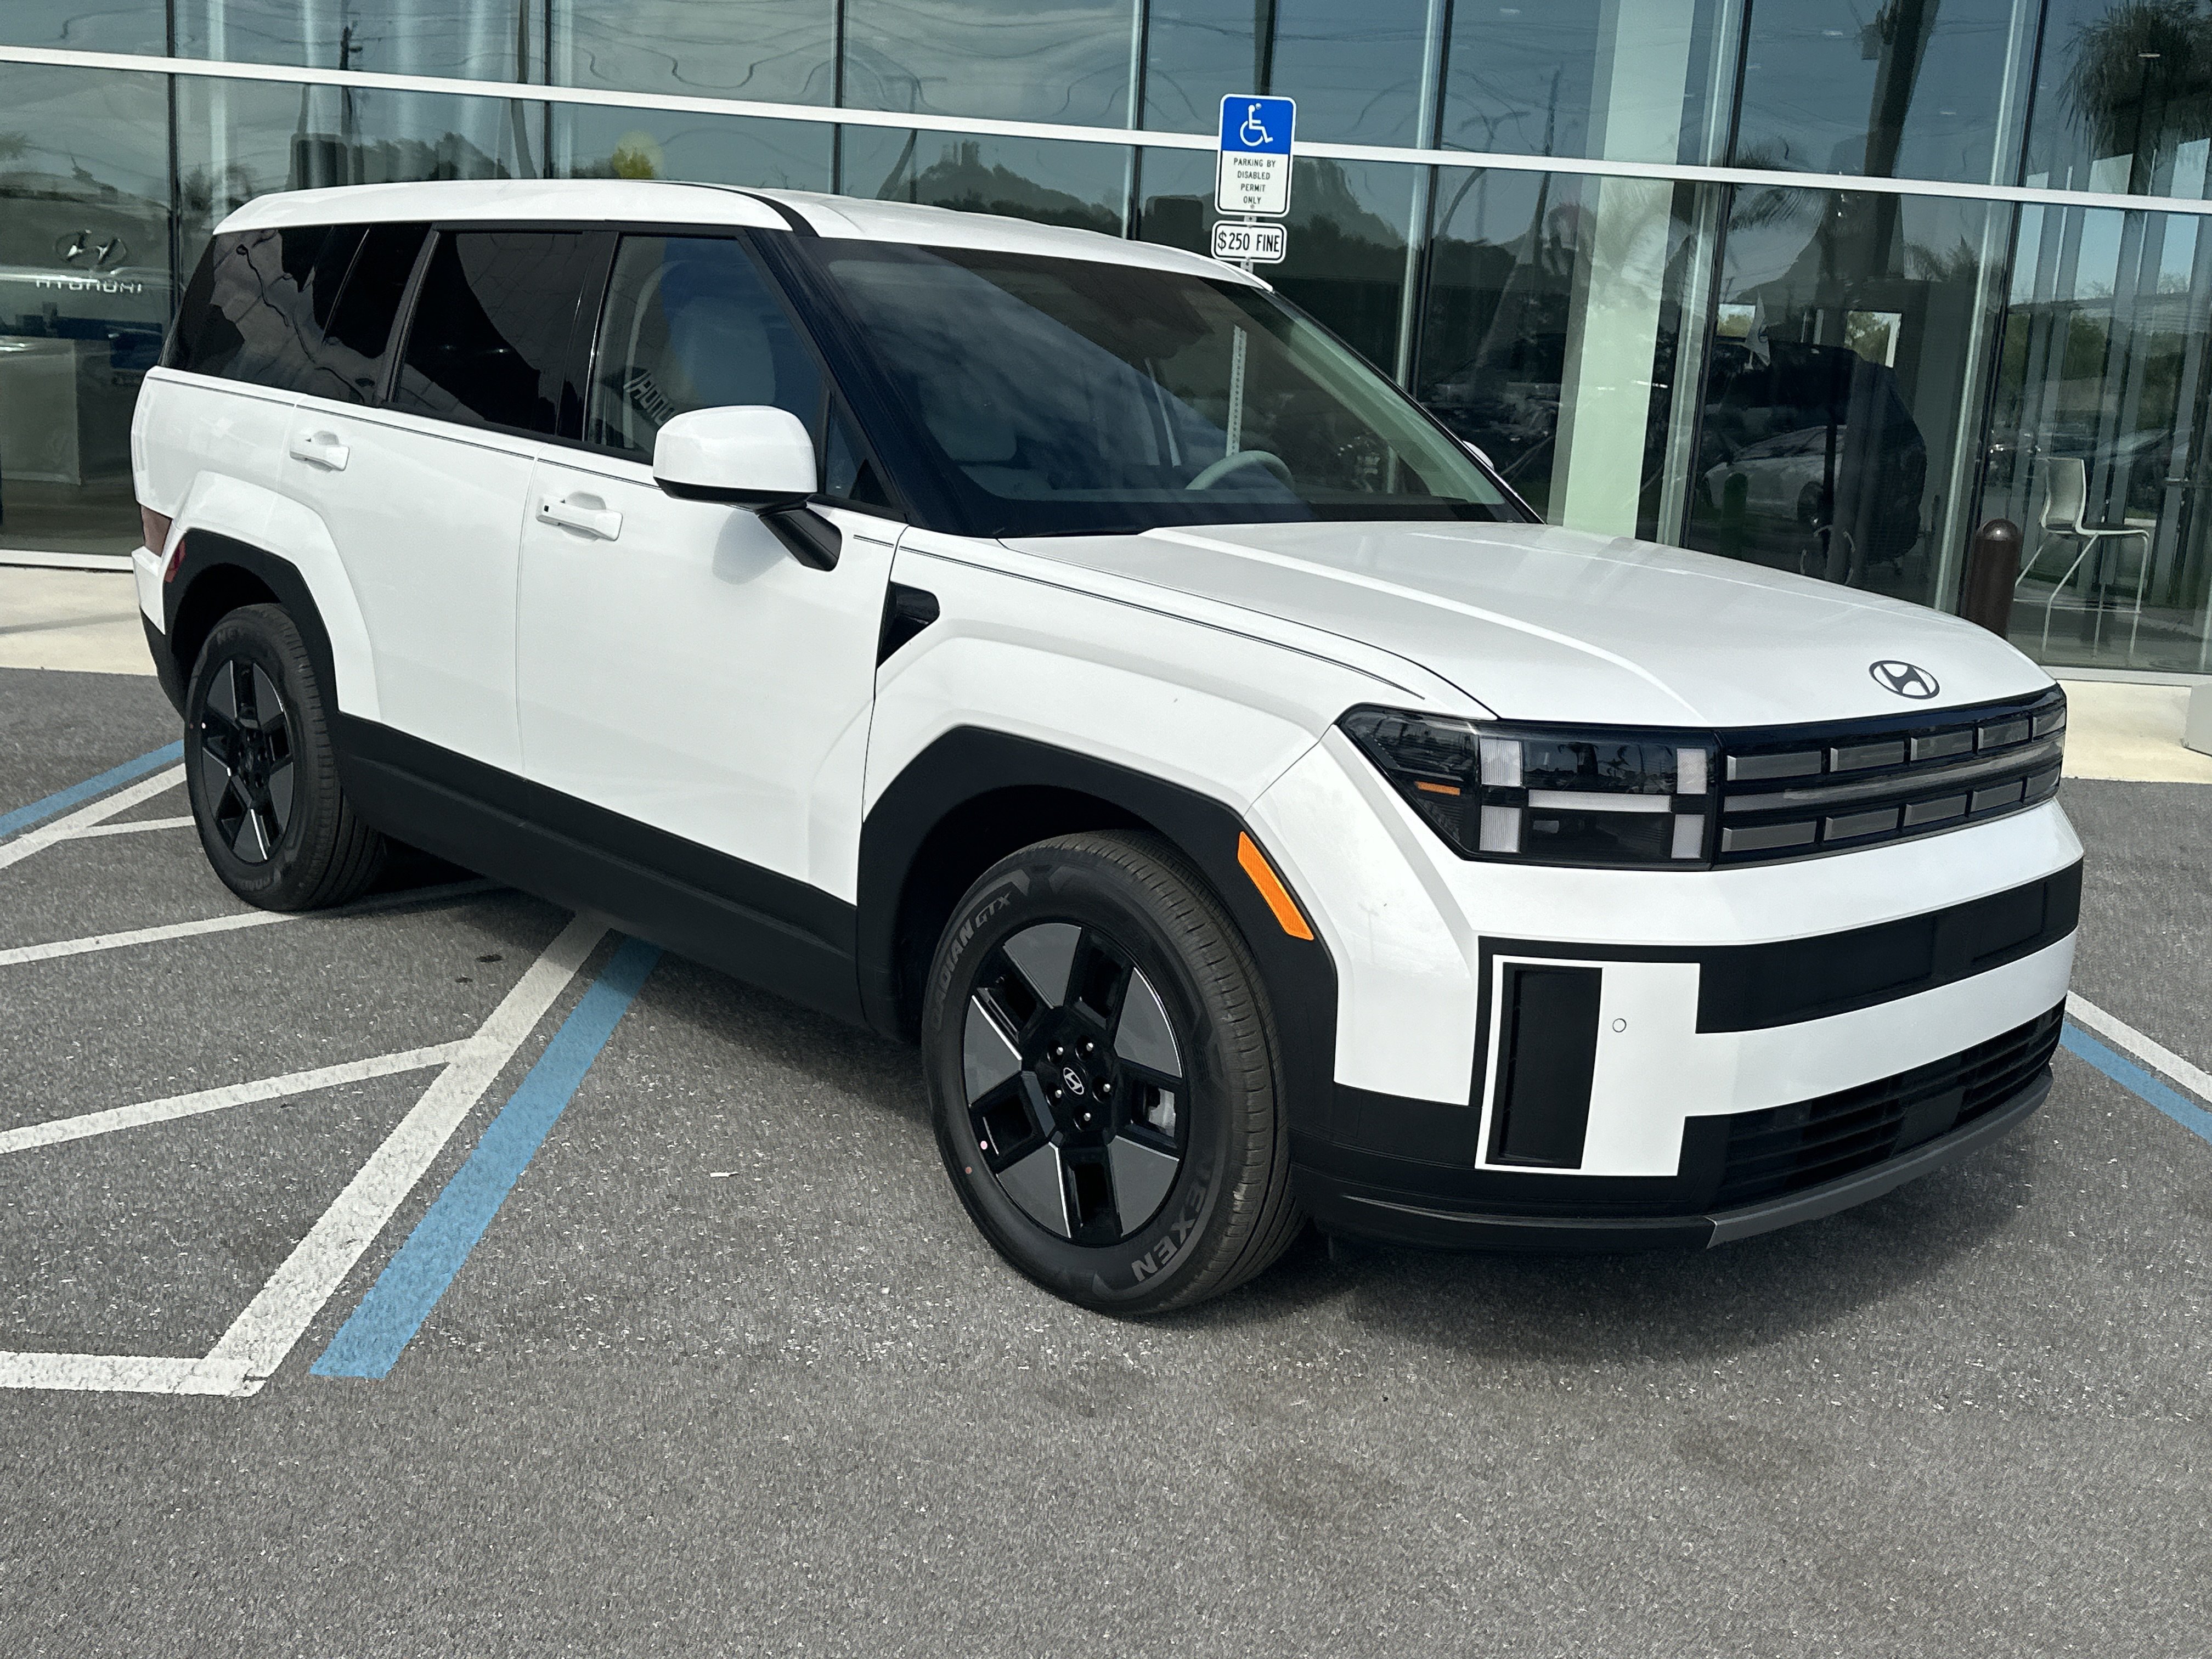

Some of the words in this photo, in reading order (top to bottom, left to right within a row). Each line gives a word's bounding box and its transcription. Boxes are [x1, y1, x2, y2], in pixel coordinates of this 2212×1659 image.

[1233, 157, 1263, 167] PARKING
[1267, 160, 1276, 168] BY
[1237, 171, 1271, 180] DISABLED
[1240, 183, 1266, 193] PERMIT
[1217, 230, 1250, 251] $250
[1256, 234, 1280, 252] FINE
[930, 918, 974, 1034] OADIAN
[975, 893, 1011, 928] GTX
